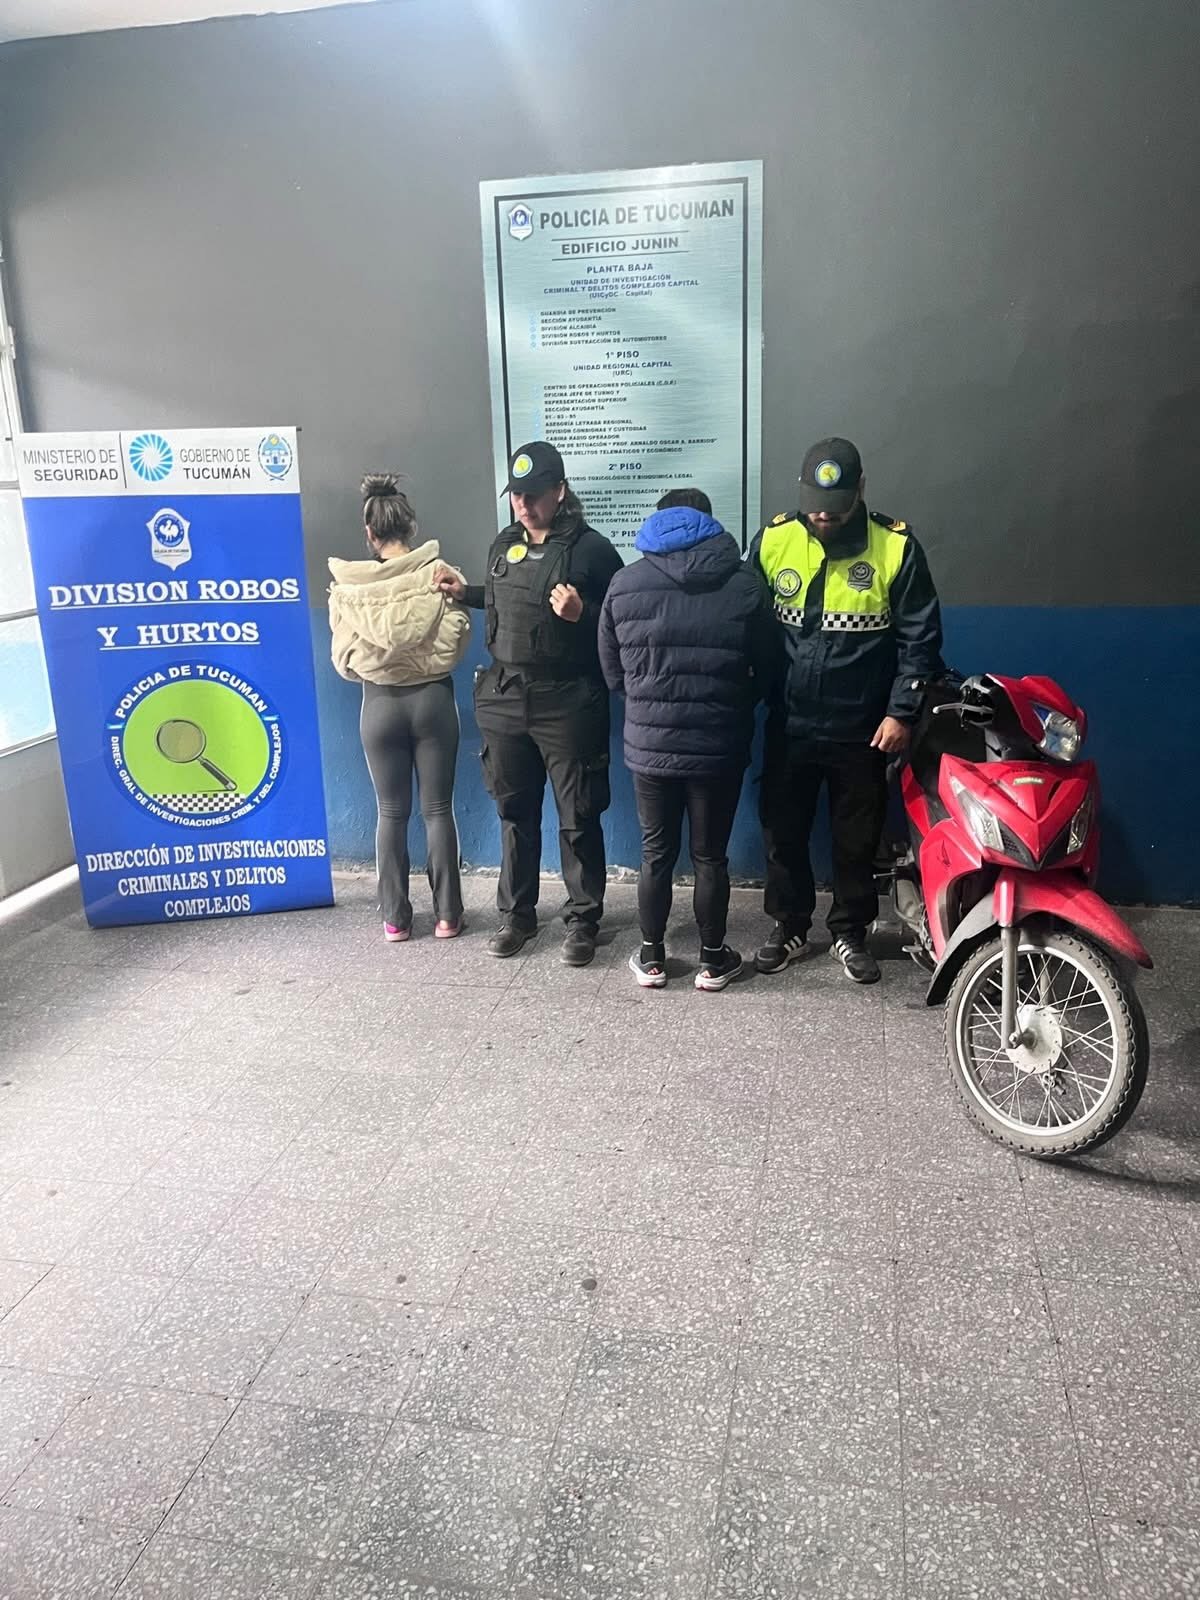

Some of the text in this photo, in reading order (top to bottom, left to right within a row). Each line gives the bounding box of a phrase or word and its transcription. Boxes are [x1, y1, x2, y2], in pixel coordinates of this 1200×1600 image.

[540, 199, 734, 230] POLICIA DE TUCUMAN
[561, 237, 679, 255] EDIFICIO JUNIN
[586, 264, 653, 274] PLANTA BAJA
[588, 284, 619, 292] DELITOS
[23, 449, 117, 464] MINISTERIO DE
[180, 448, 250, 463] GOBIERNO DE
[34, 468, 118, 482] SEGURIDAD
[183, 464, 251, 480] TUCUMÁN
[49, 578, 300, 606] DIVISION ROBOS
[97, 621, 259, 647] Y HURTOS
[115, 664, 268, 719] POLICIA DE TUCUMAN
[111, 736, 123, 769] DIREC.
[118, 770, 138, 795] GRAL
[135, 793, 148, 807] DE
[146, 803, 231, 827] INVESTIGACIONES
[269, 723, 282, 779] COMPLEJOS
[86, 839, 326, 872] DIRECCIÓN DE INVESTIGACIONES
[118, 866, 286, 896] CRIMINALES Y DELITOS
[164, 894, 250, 917] COMPLEJOS
